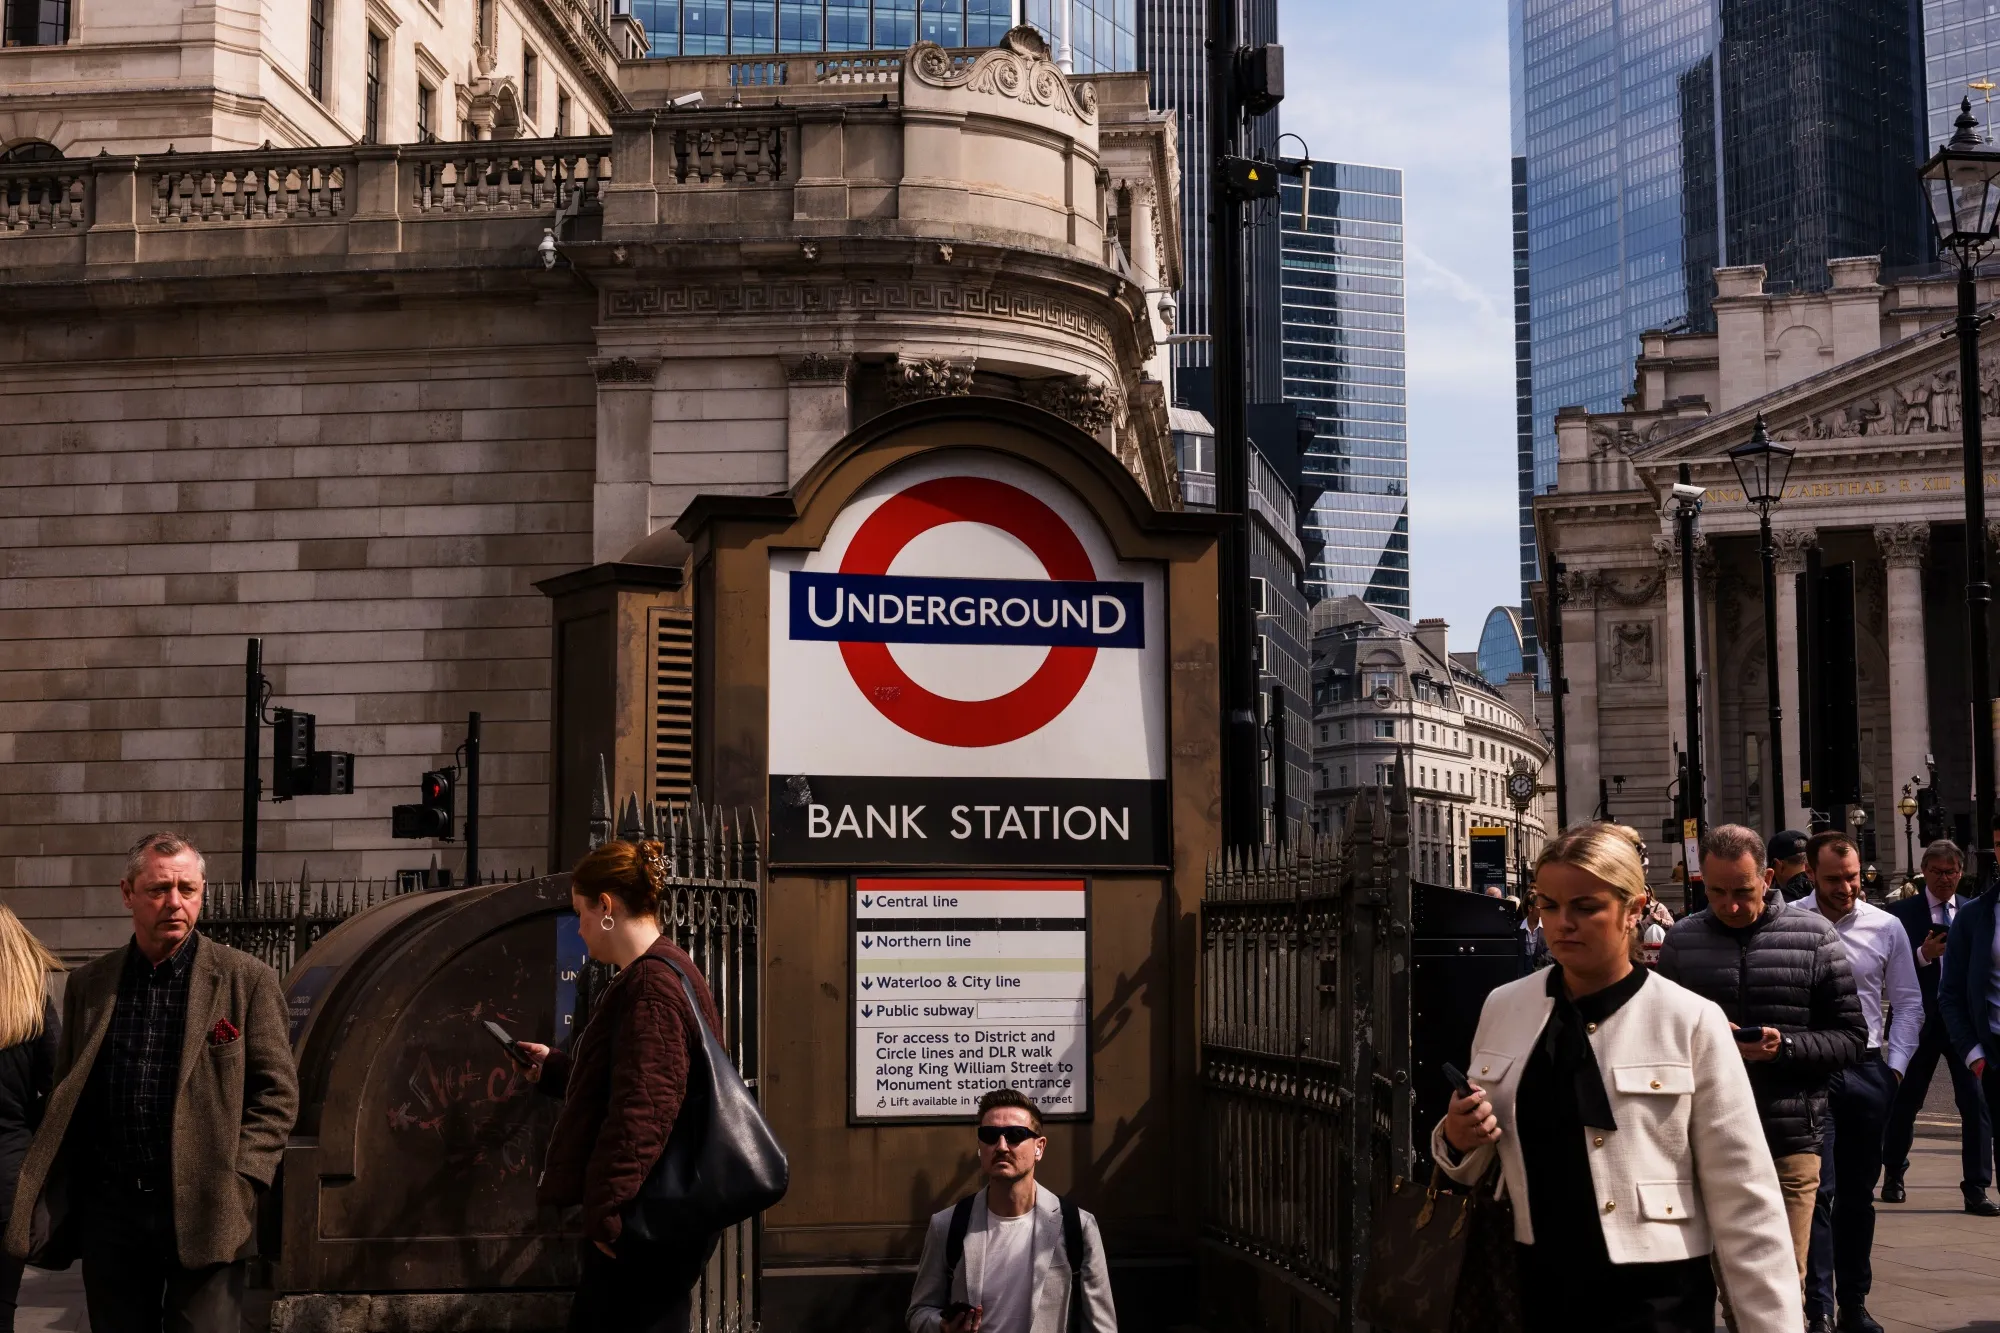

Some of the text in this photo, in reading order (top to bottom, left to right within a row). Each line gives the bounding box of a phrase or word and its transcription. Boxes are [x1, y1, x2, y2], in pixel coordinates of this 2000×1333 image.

[1703, 487, 1743, 503] NNO
[1899, 478, 1912, 493] R
[809, 586, 1127, 634] UNDERGROUND
[809, 804, 1128, 840] BANK STATION
[876, 895, 959, 908] Central line
[876, 934, 972, 948] Northern line
[876, 975, 1021, 991] Waterloo & City line
[876, 1004, 975, 1019] Public subway
[876, 1029, 1055, 1044] For access to District and
[876, 1045, 1053, 1060] Circle lines and DLR walk
[875, 1061, 1074, 1078] along King William Street to
[876, 1077, 1072, 1091] Monument station entrance
[890, 1096, 910, 1107] Lift
[912, 1096, 958, 1106] available
[960, 1096, 970, 1105] in
[1040, 1095, 1073, 1105] street
